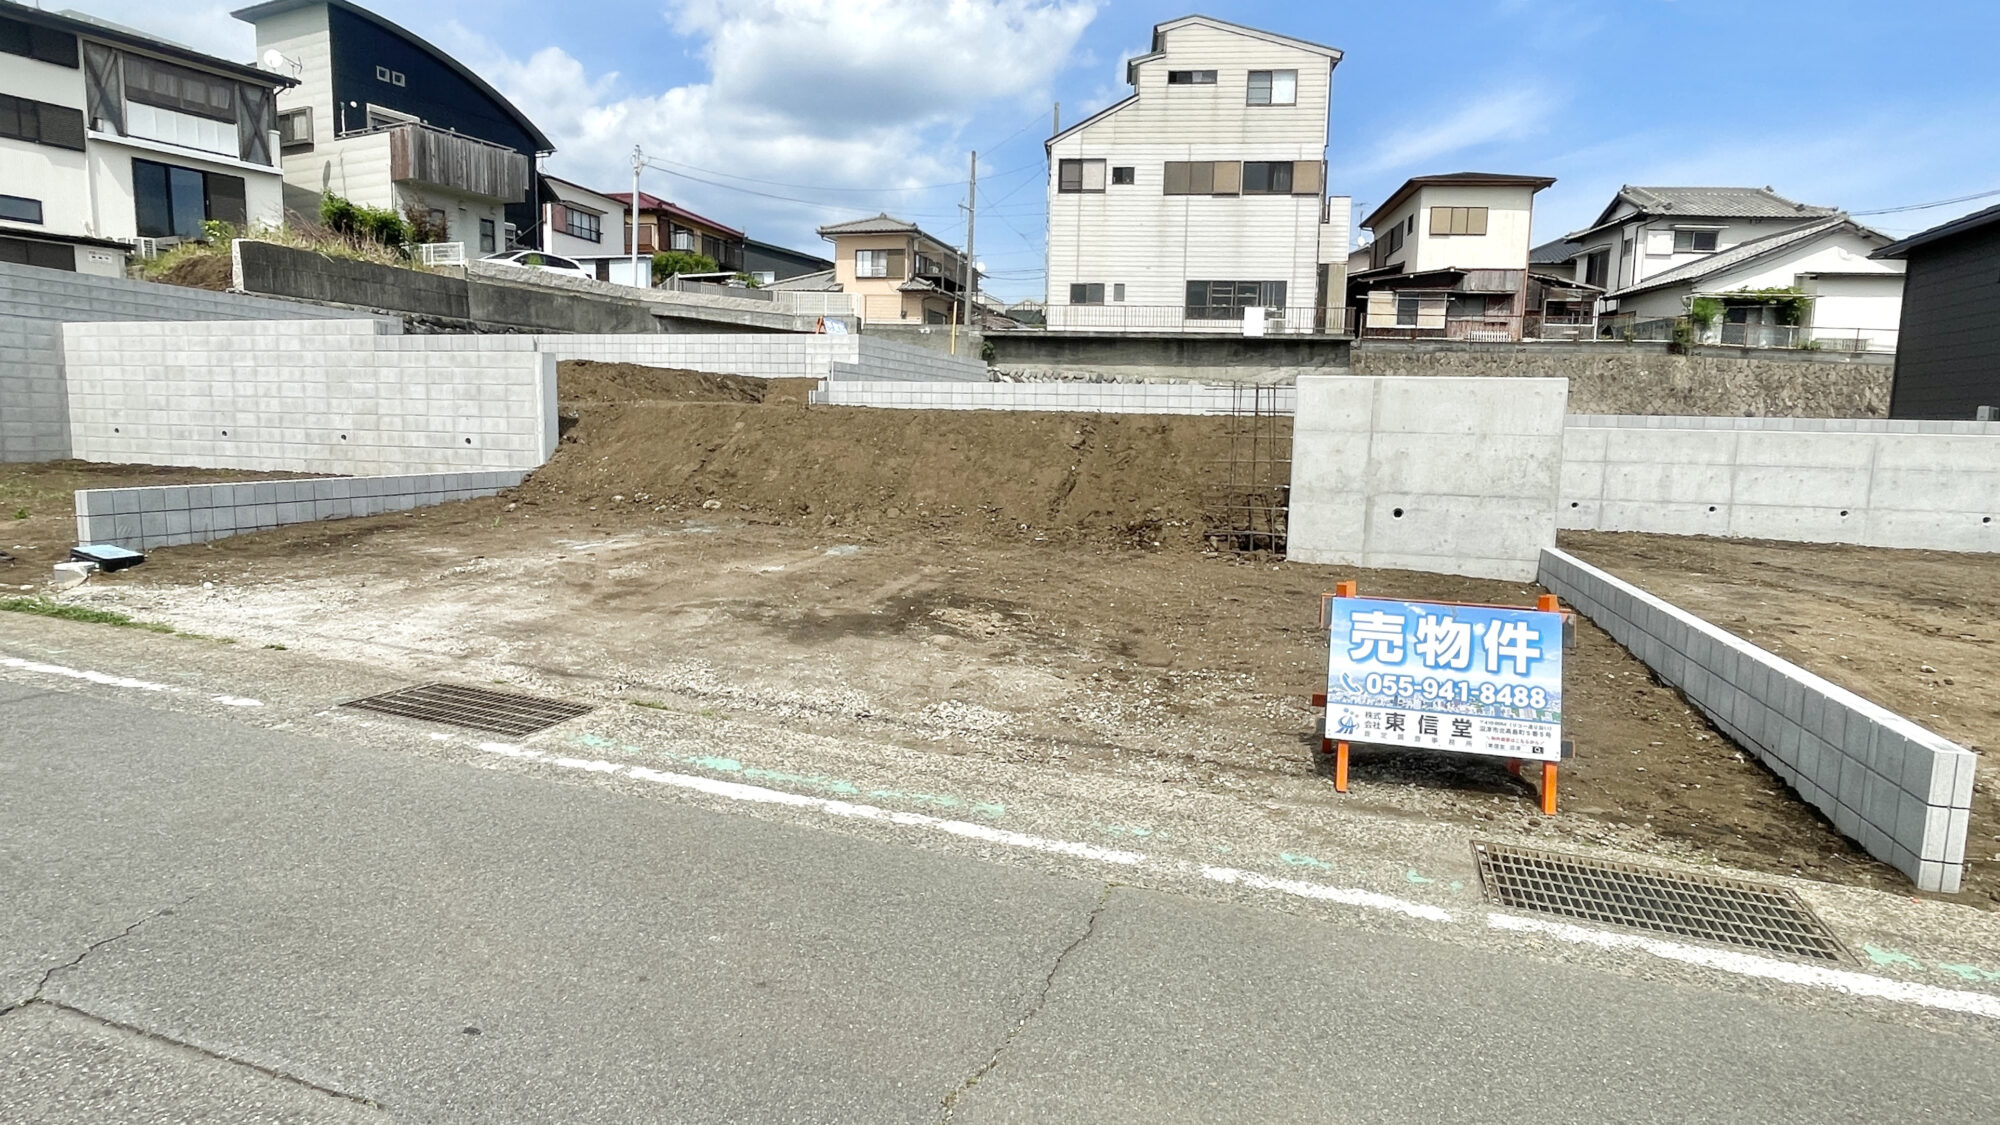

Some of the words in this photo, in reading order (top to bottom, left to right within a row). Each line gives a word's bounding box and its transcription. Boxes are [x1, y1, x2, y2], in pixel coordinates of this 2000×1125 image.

[1350, 612, 1542, 673] 売物件
[1366, 673, 1547, 707] 055-941-8488
[1365, 711, 1381, 720] 株式
[1365, 721, 1381, 730] 会社
[1385, 712, 1472, 738] 東信堂
